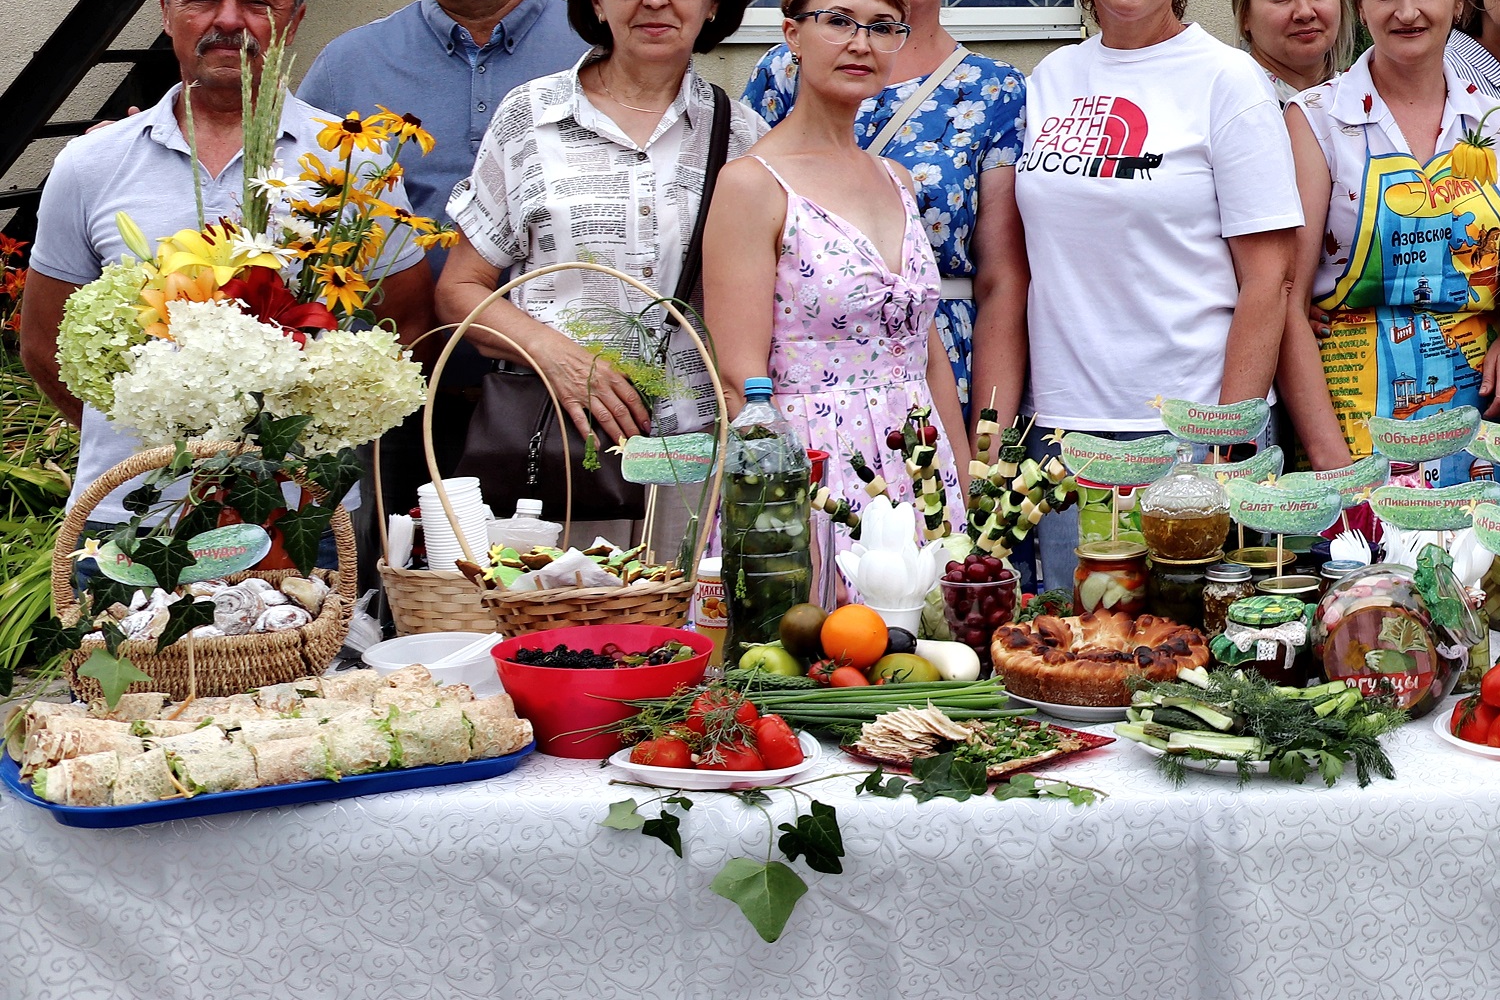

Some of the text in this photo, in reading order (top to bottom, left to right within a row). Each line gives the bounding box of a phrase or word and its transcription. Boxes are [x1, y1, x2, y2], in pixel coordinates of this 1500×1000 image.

[1070, 95, 1112, 117] THE
[1041, 115, 1105, 137] ORTH
[1031, 133, 1100, 157] FACE
[1391, 226, 1453, 247] Азовское
[1392, 250, 1427, 267] море
[1187, 408, 1242, 422] Огурчики
[1178, 423, 1249, 437] «Пикничок»
[1377, 427, 1472, 446] «Объедение»
[1315, 469, 1356, 481] Варенье
[1239, 500, 1318, 512] Салат «Улёт»
[1377, 497, 1442, 507] «Пикантные
